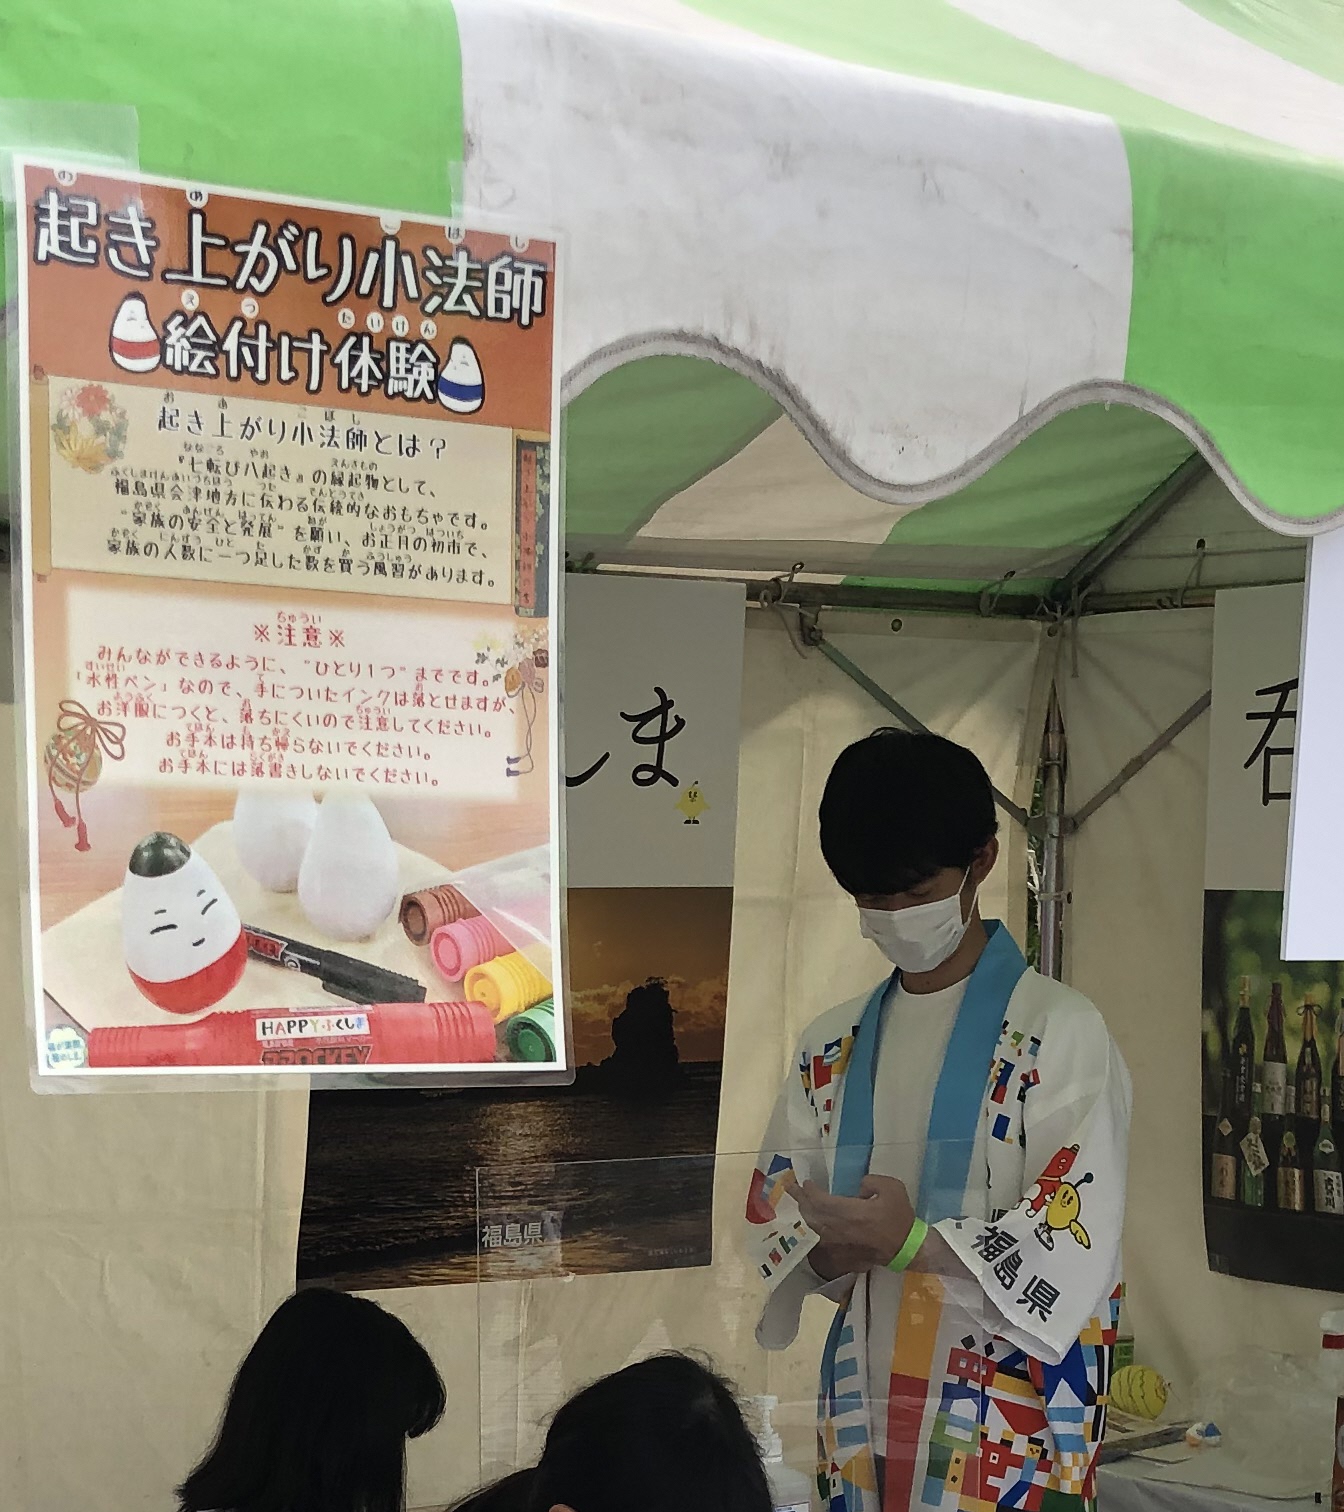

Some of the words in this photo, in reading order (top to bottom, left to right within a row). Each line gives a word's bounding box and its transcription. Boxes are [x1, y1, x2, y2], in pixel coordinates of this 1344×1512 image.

[33, 186, 546, 328] 起き上がり小法師
[163, 310, 440, 403] 絵付け体験
[158, 405, 447, 460] 起き上がり小法師とは？
[115, 477, 488, 531] 福島県会津地方に伝わる伝統的なおもちゃです。
[107, 539, 495, 588] 家族の人数に一つ足した数を買う風習があります。
[97, 699, 491, 739] お洋服につくと、落ちにくいので注意してください。
[158, 757, 439, 787] お手本には落書きしないでください。
[481, 1222, 545, 1249] 福島県
[971, 1223, 1061, 1324] 福島県
